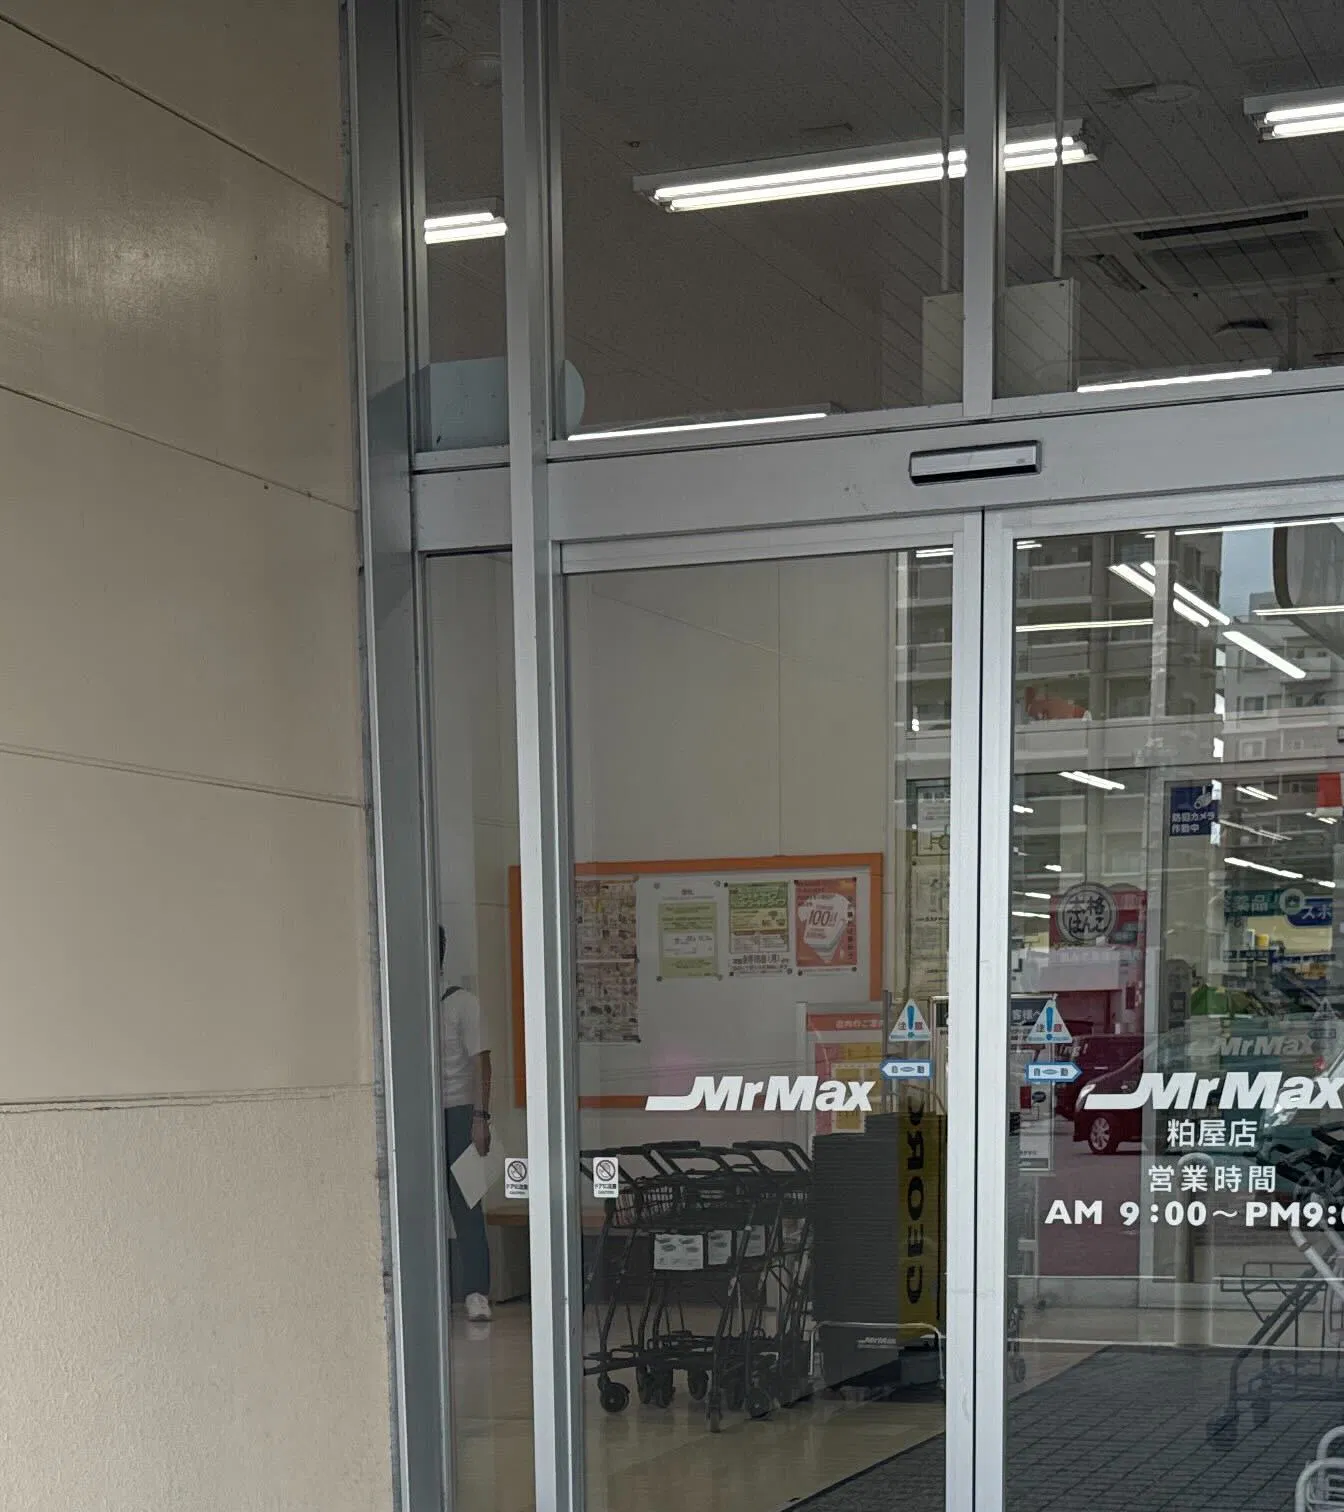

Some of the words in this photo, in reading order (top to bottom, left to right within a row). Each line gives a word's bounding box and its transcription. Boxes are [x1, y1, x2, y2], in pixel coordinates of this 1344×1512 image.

[644, 1075, 873, 1112] MrMax
[1166, 1118, 1258, 1149] 粕屋店
[1147, 1164, 1277, 1193] 営業時間
[1044, 1200, 1103, 1225] AM
